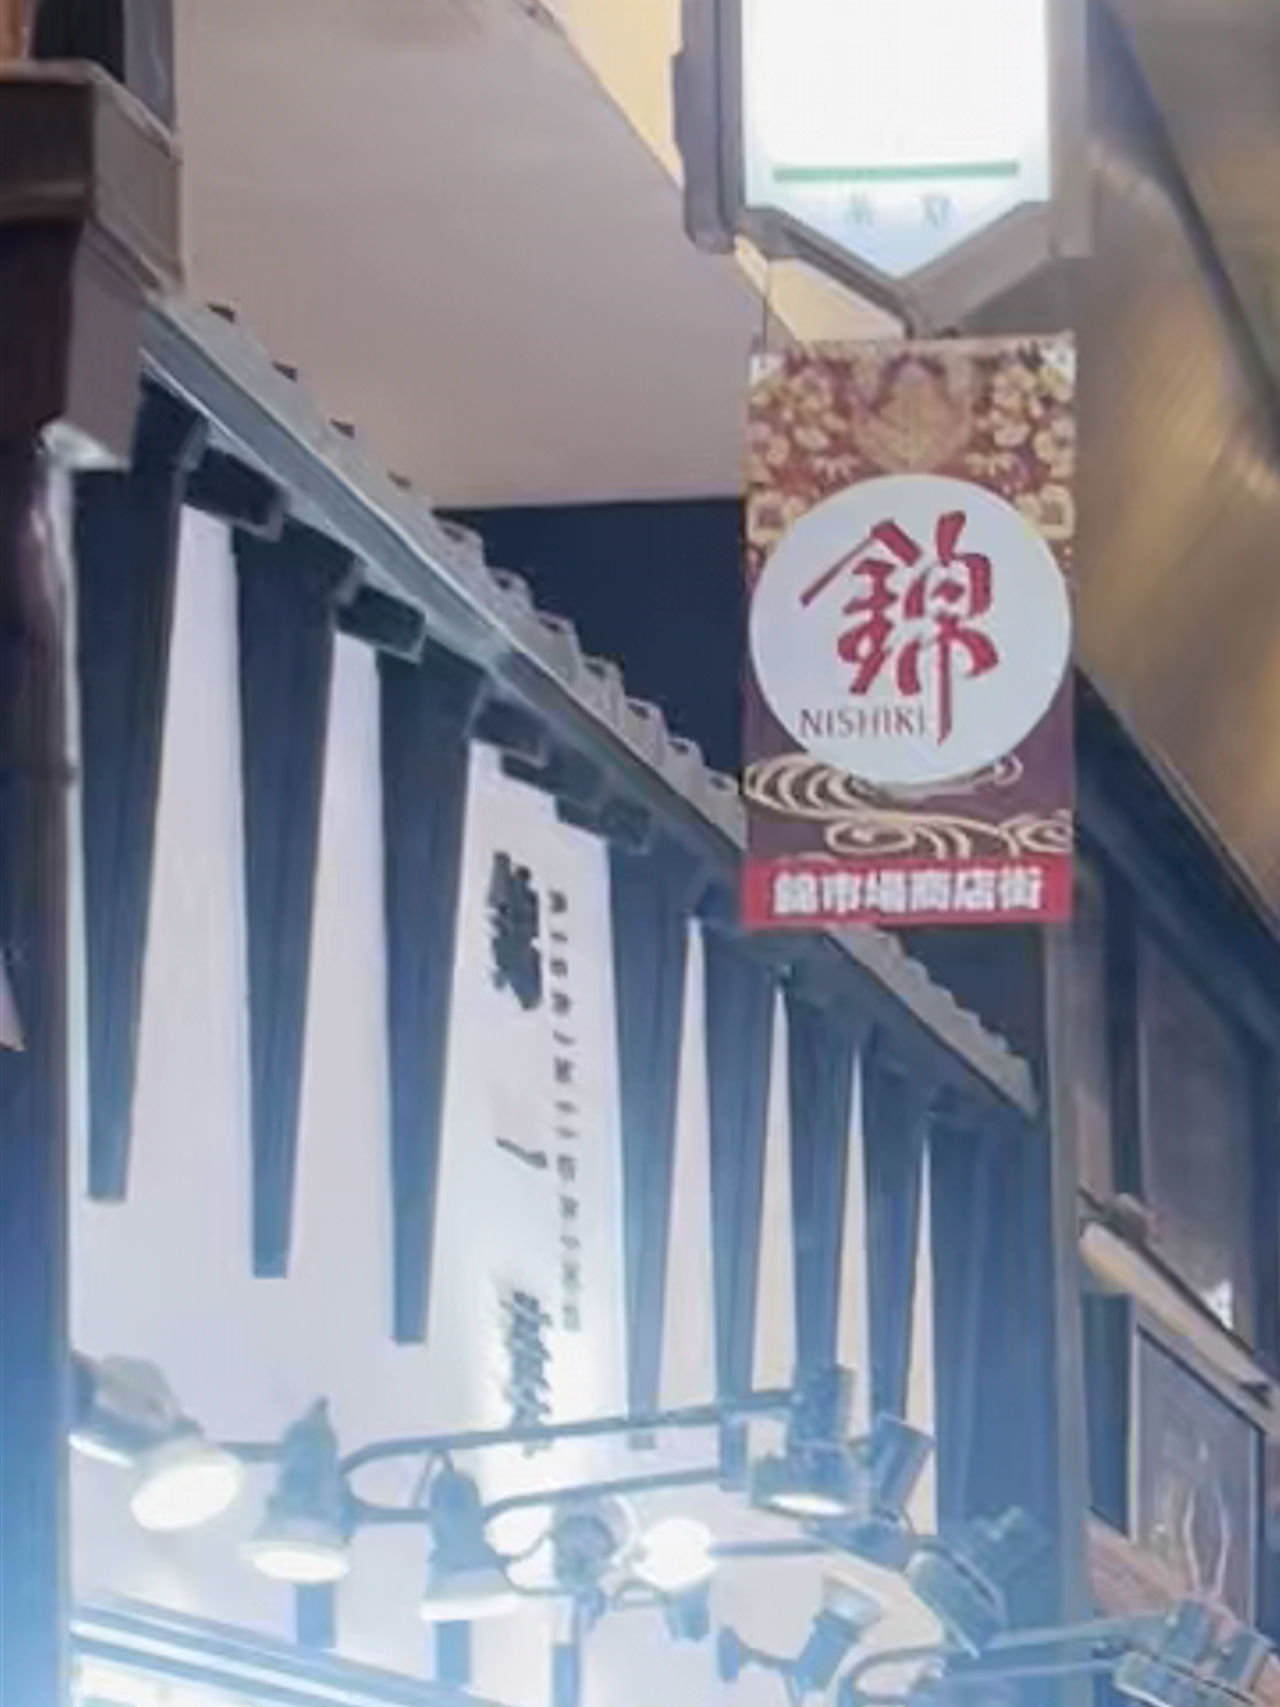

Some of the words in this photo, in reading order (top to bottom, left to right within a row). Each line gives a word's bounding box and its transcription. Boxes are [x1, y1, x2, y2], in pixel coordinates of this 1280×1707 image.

[800, 510, 999, 746] 錦
[800, 708, 927, 740] NISHIKI
[772, 864, 1044, 915] 錦市場商店街
